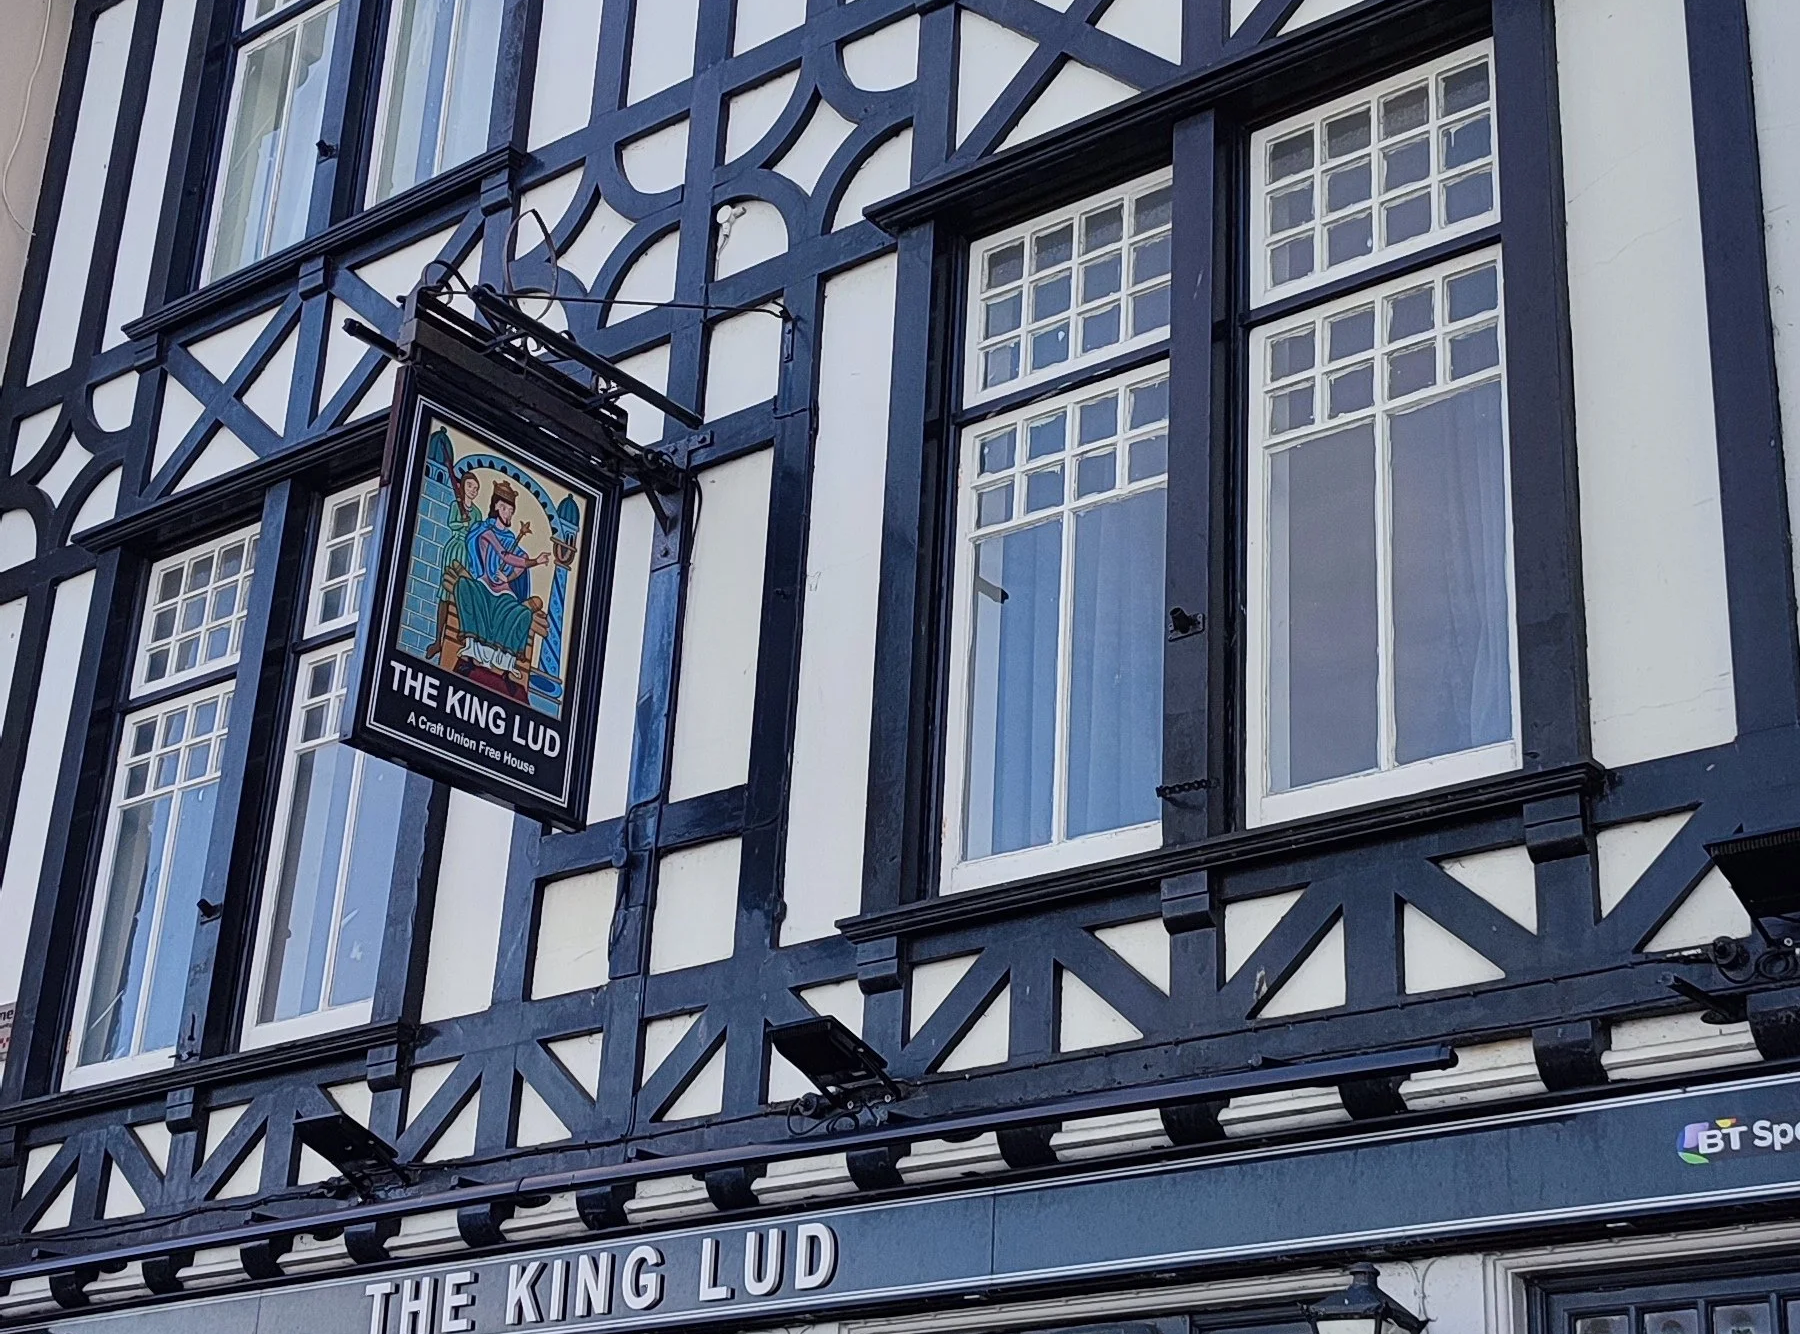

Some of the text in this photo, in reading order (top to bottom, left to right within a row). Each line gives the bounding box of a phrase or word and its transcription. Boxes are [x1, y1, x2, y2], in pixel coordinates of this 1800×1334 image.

[390, 660, 561, 759] THE KING LUD
[406, 711, 535, 775] A Craft Union Free House
[1697, 1120, 1800, 1154] BT Sp
[505, 1244, 666, 1327] KING
[698, 1221, 840, 1302] LUD
